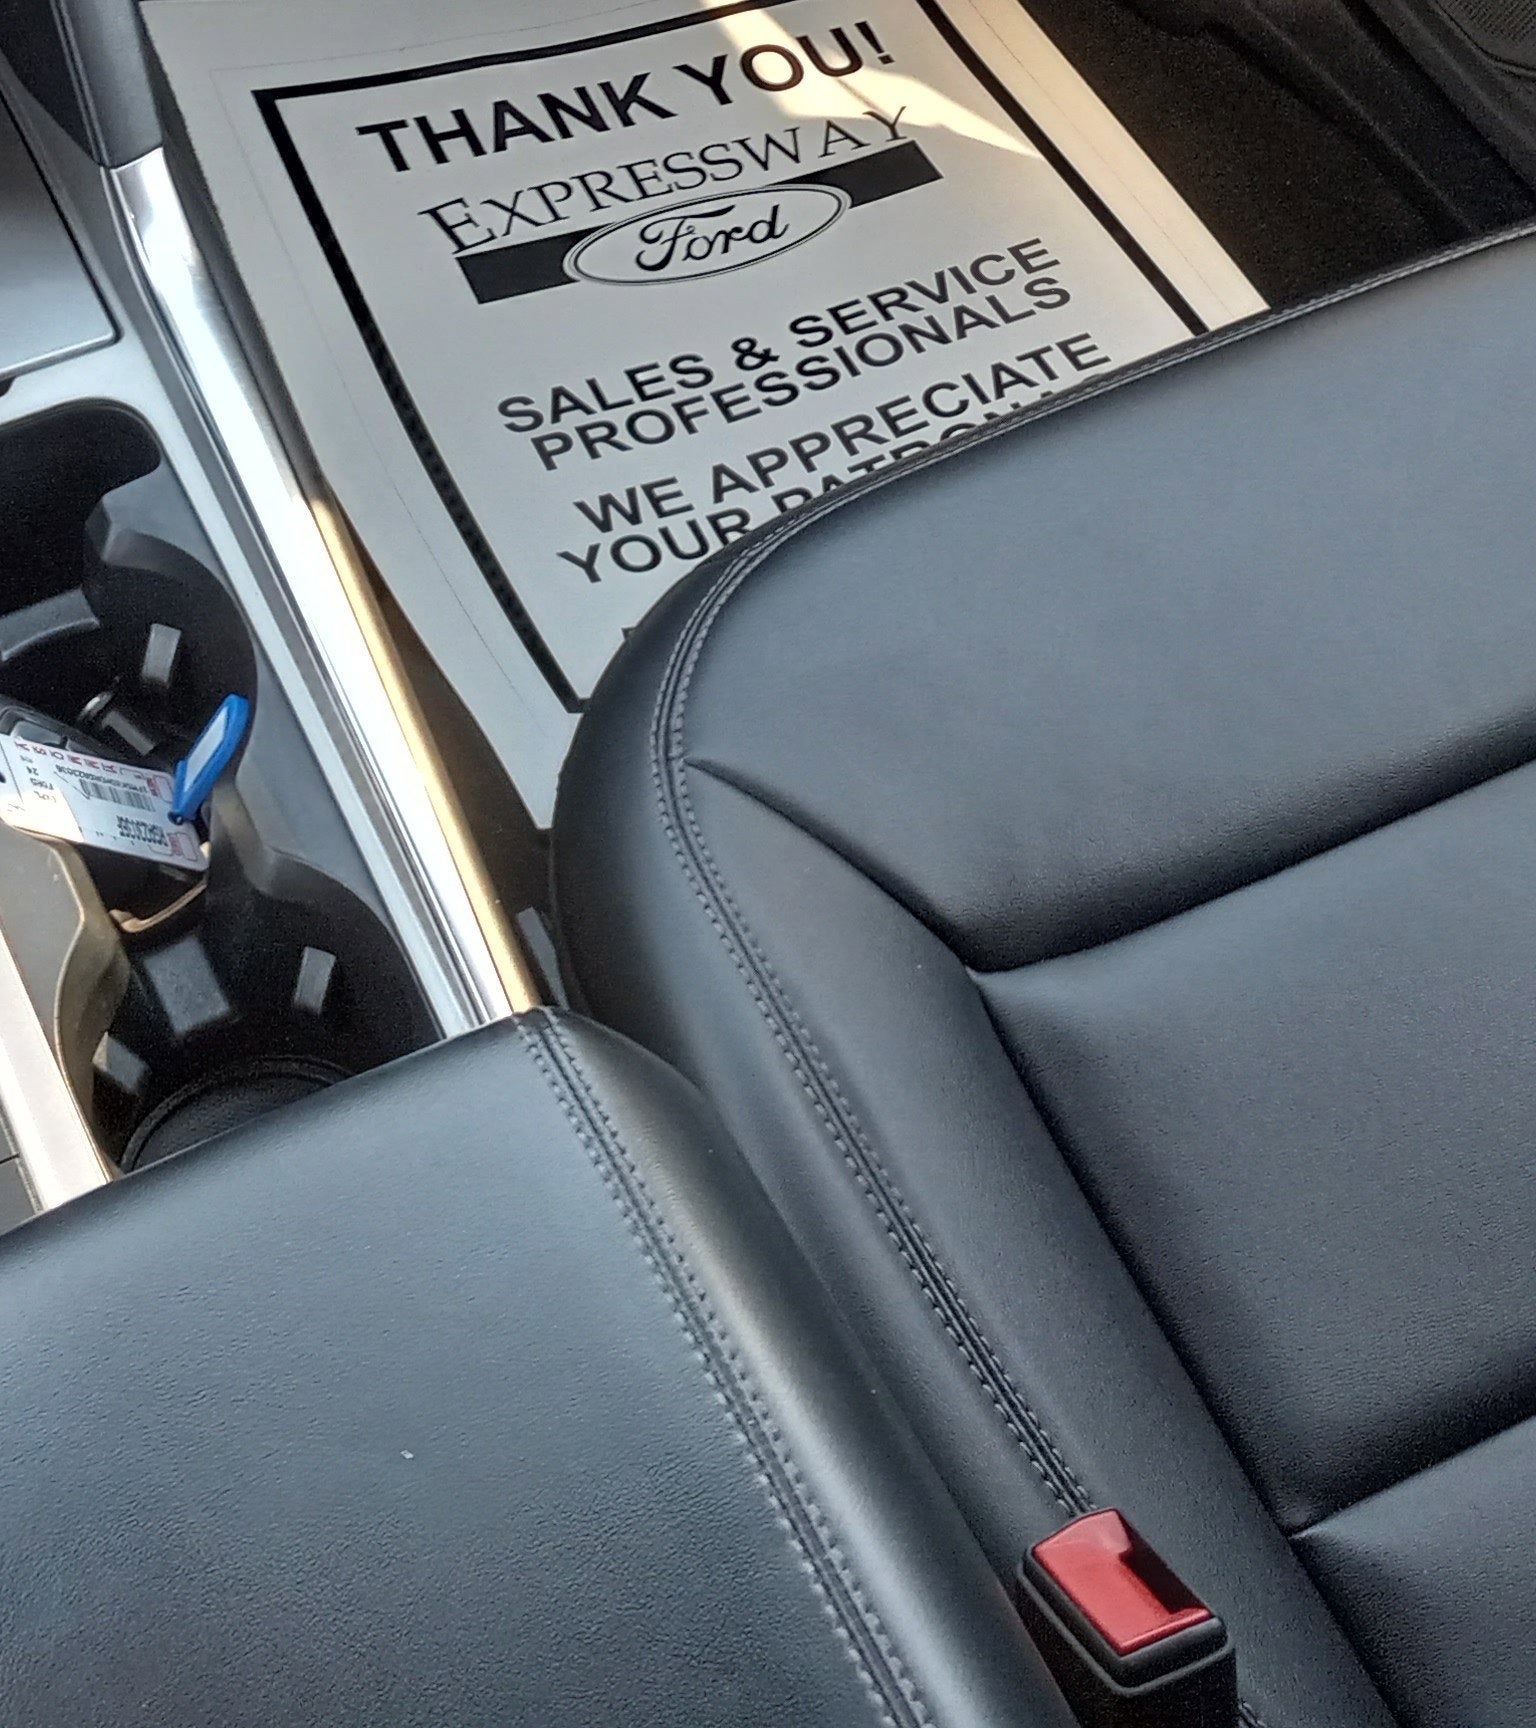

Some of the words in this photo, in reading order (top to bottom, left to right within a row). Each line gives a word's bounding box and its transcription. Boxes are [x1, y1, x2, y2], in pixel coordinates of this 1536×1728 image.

[356, 72, 678, 173] THANK
[674, 21, 894, 107] YOU!
[419, 105, 911, 255] EXPRESSWAY
[634, 201, 789, 272] Ford
[498, 349, 714, 435] SALES
[731, 332, 781, 373] &
[787, 236, 1061, 352] SERVICE
[529, 274, 1072, 472] PROFESSIONALS
[573, 473, 693, 536] WE
[709, 332, 1110, 491] APPRECIATE
[556, 505, 753, 585] YOUR
